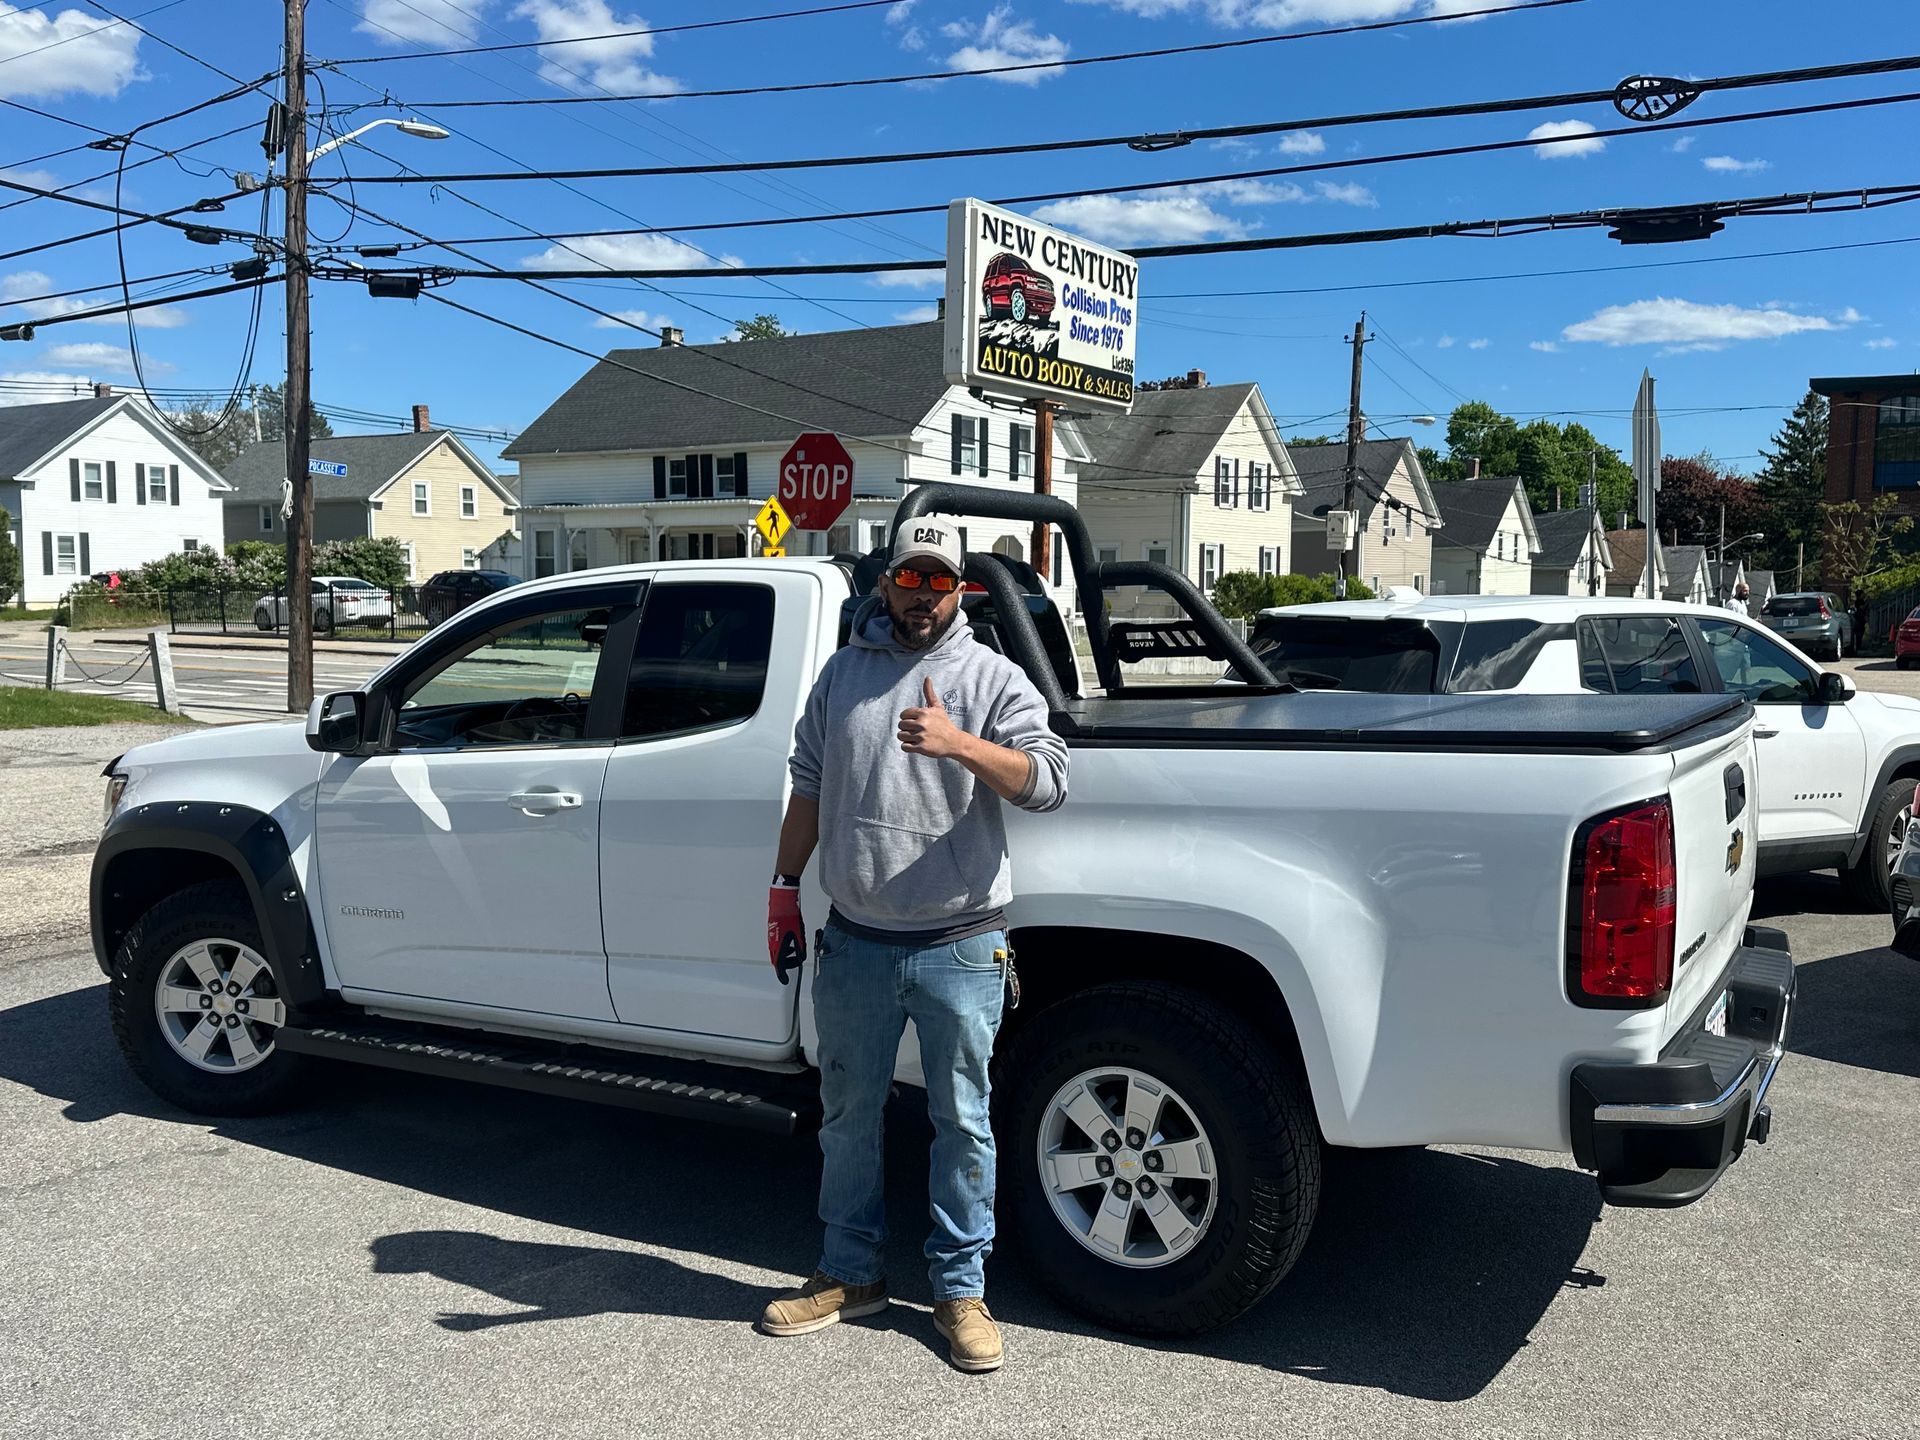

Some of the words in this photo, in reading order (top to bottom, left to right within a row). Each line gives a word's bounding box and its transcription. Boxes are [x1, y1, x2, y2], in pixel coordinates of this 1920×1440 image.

[981, 213, 1035, 258] NEW
[1042, 236, 1138, 300] CENTURY
[1062, 283, 1107, 317] Collision
[1109, 297, 1132, 327] Pros
[1069, 315, 1099, 345] Since
[1101, 326, 1123, 351] 1976
[981, 345, 1034, 380] AUTO
[1037, 358, 1084, 391] BODY
[1084, 375, 1094, 392] &
[1095, 376, 1131, 401] SALES
[1112, 355, 1134, 374] Lic#356
[310, 461, 338, 474] POCASSET
[782, 463, 849, 500] STOP
[913, 527, 945, 547] CAT
[1794, 792, 1842, 800] EQUINOX
